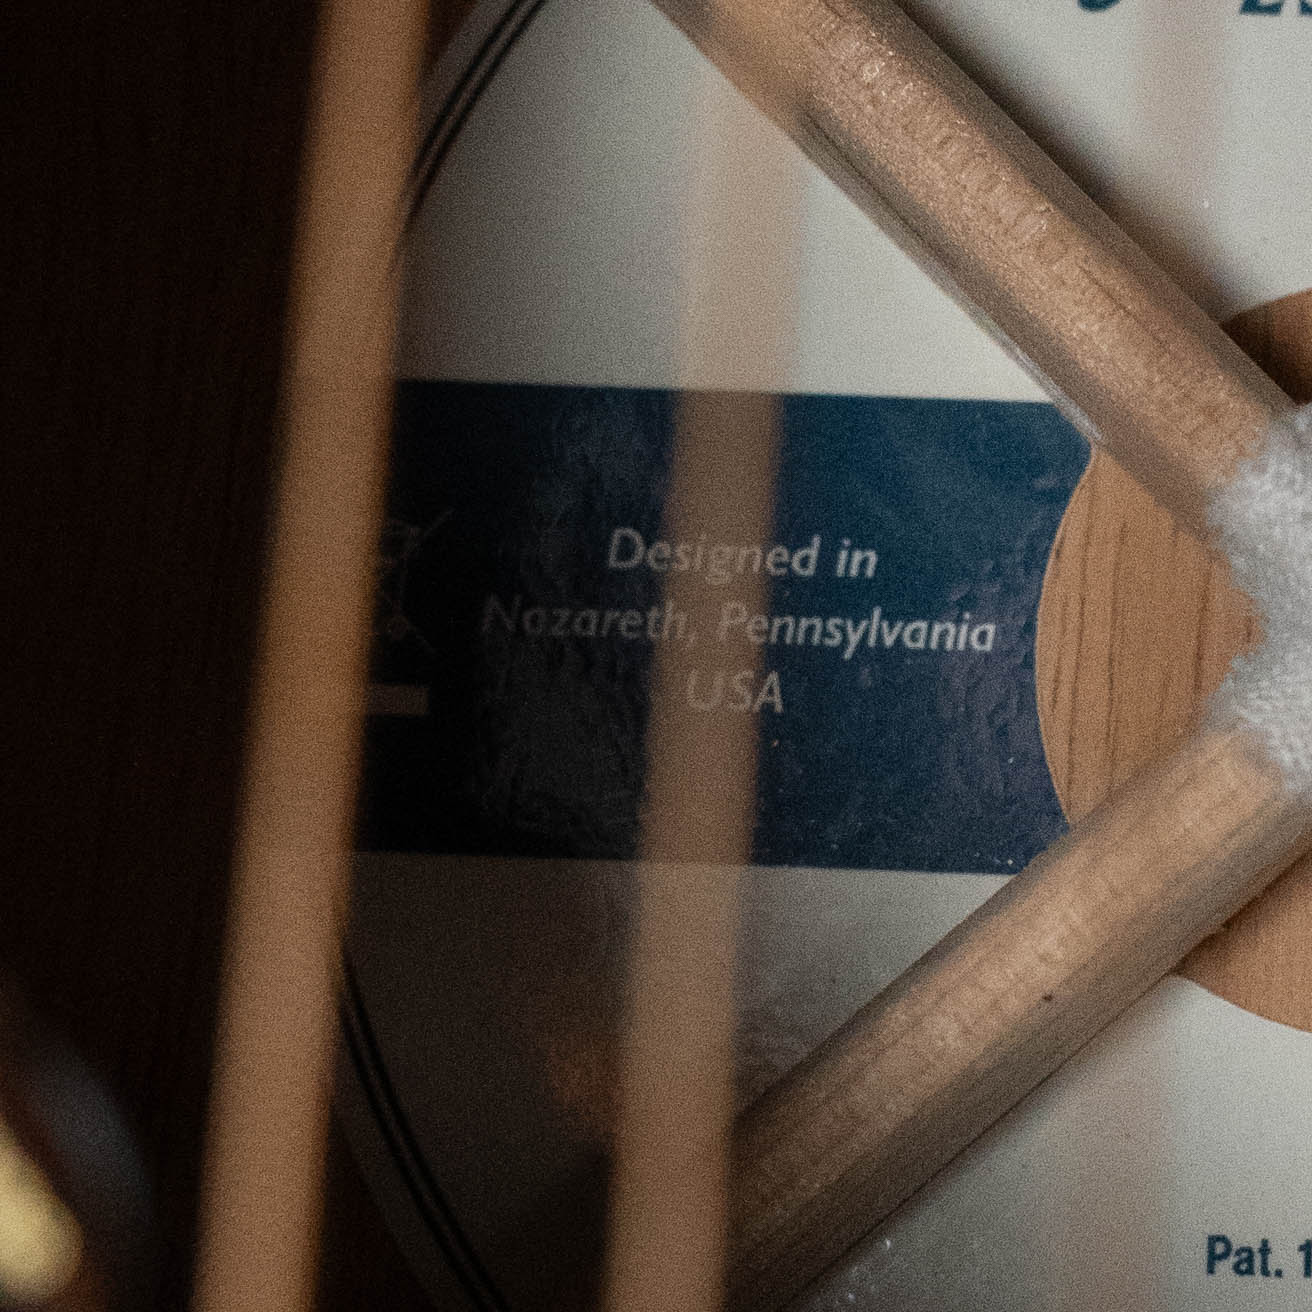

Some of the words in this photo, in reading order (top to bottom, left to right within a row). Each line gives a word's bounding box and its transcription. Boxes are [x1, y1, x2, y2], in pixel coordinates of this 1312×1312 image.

[605, 526, 821, 585] Designed
[835, 538, 879, 578] in
[479, 593, 700, 646] Nazareth,
[716, 600, 997, 661] Pennsylvania
[686, 669, 786, 715] USA
[1206, 1233, 1284, 1279] Pat.
